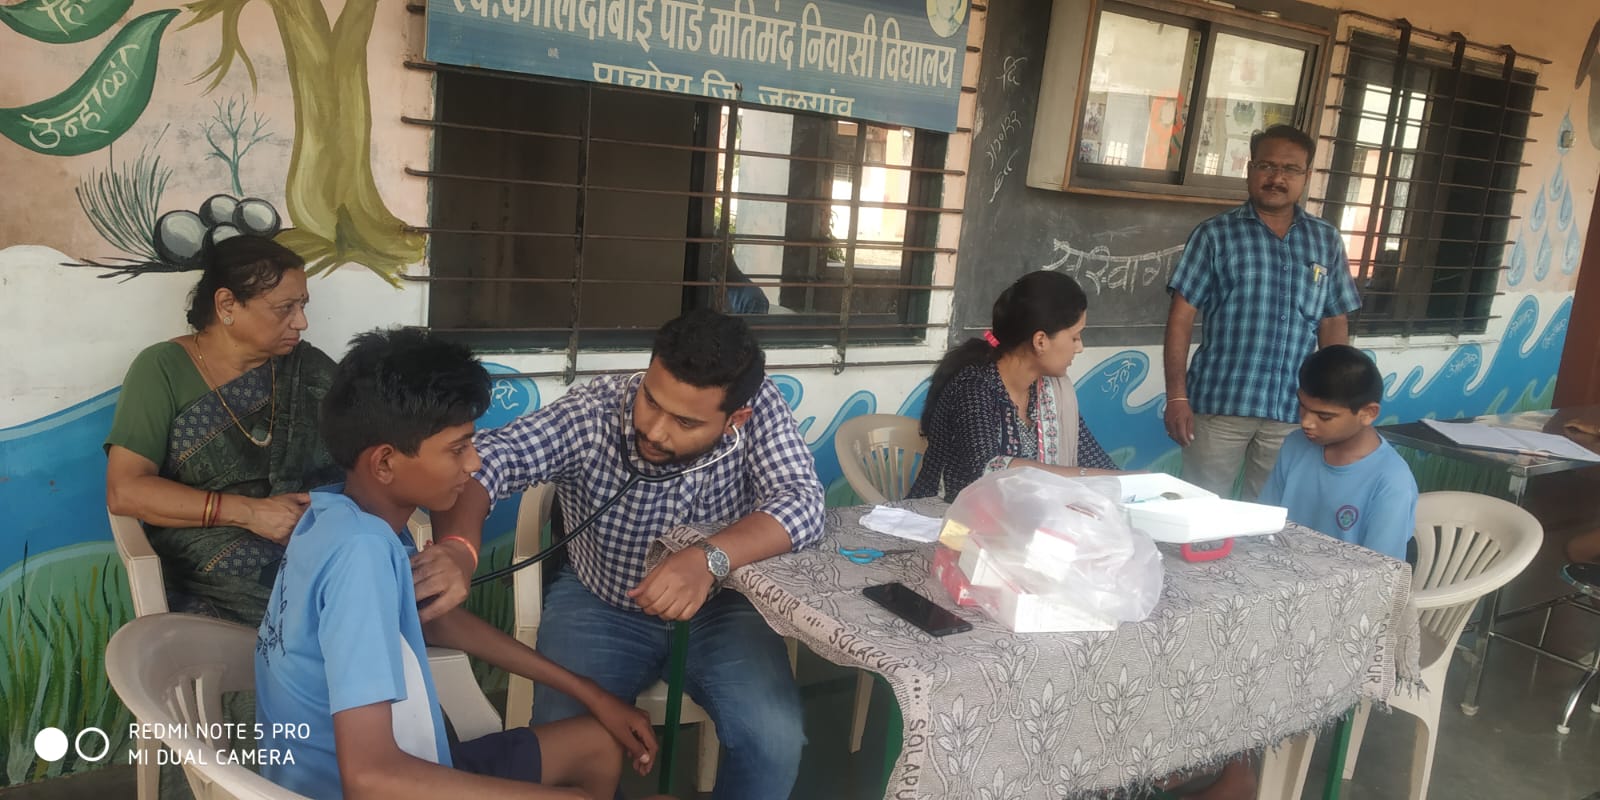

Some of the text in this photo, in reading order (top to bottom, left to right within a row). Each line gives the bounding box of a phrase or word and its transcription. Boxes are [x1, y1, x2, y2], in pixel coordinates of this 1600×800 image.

[800, 3, 877, 78] निवासी
[880, 17, 957, 88] विद्यालय
[592, 61, 694, 93] पाचोरा
[741, 570, 800, 621] SOLAPUR
[829, 627, 908, 677] SOLAPUR
[896, 719, 926, 800] SOLAPU
